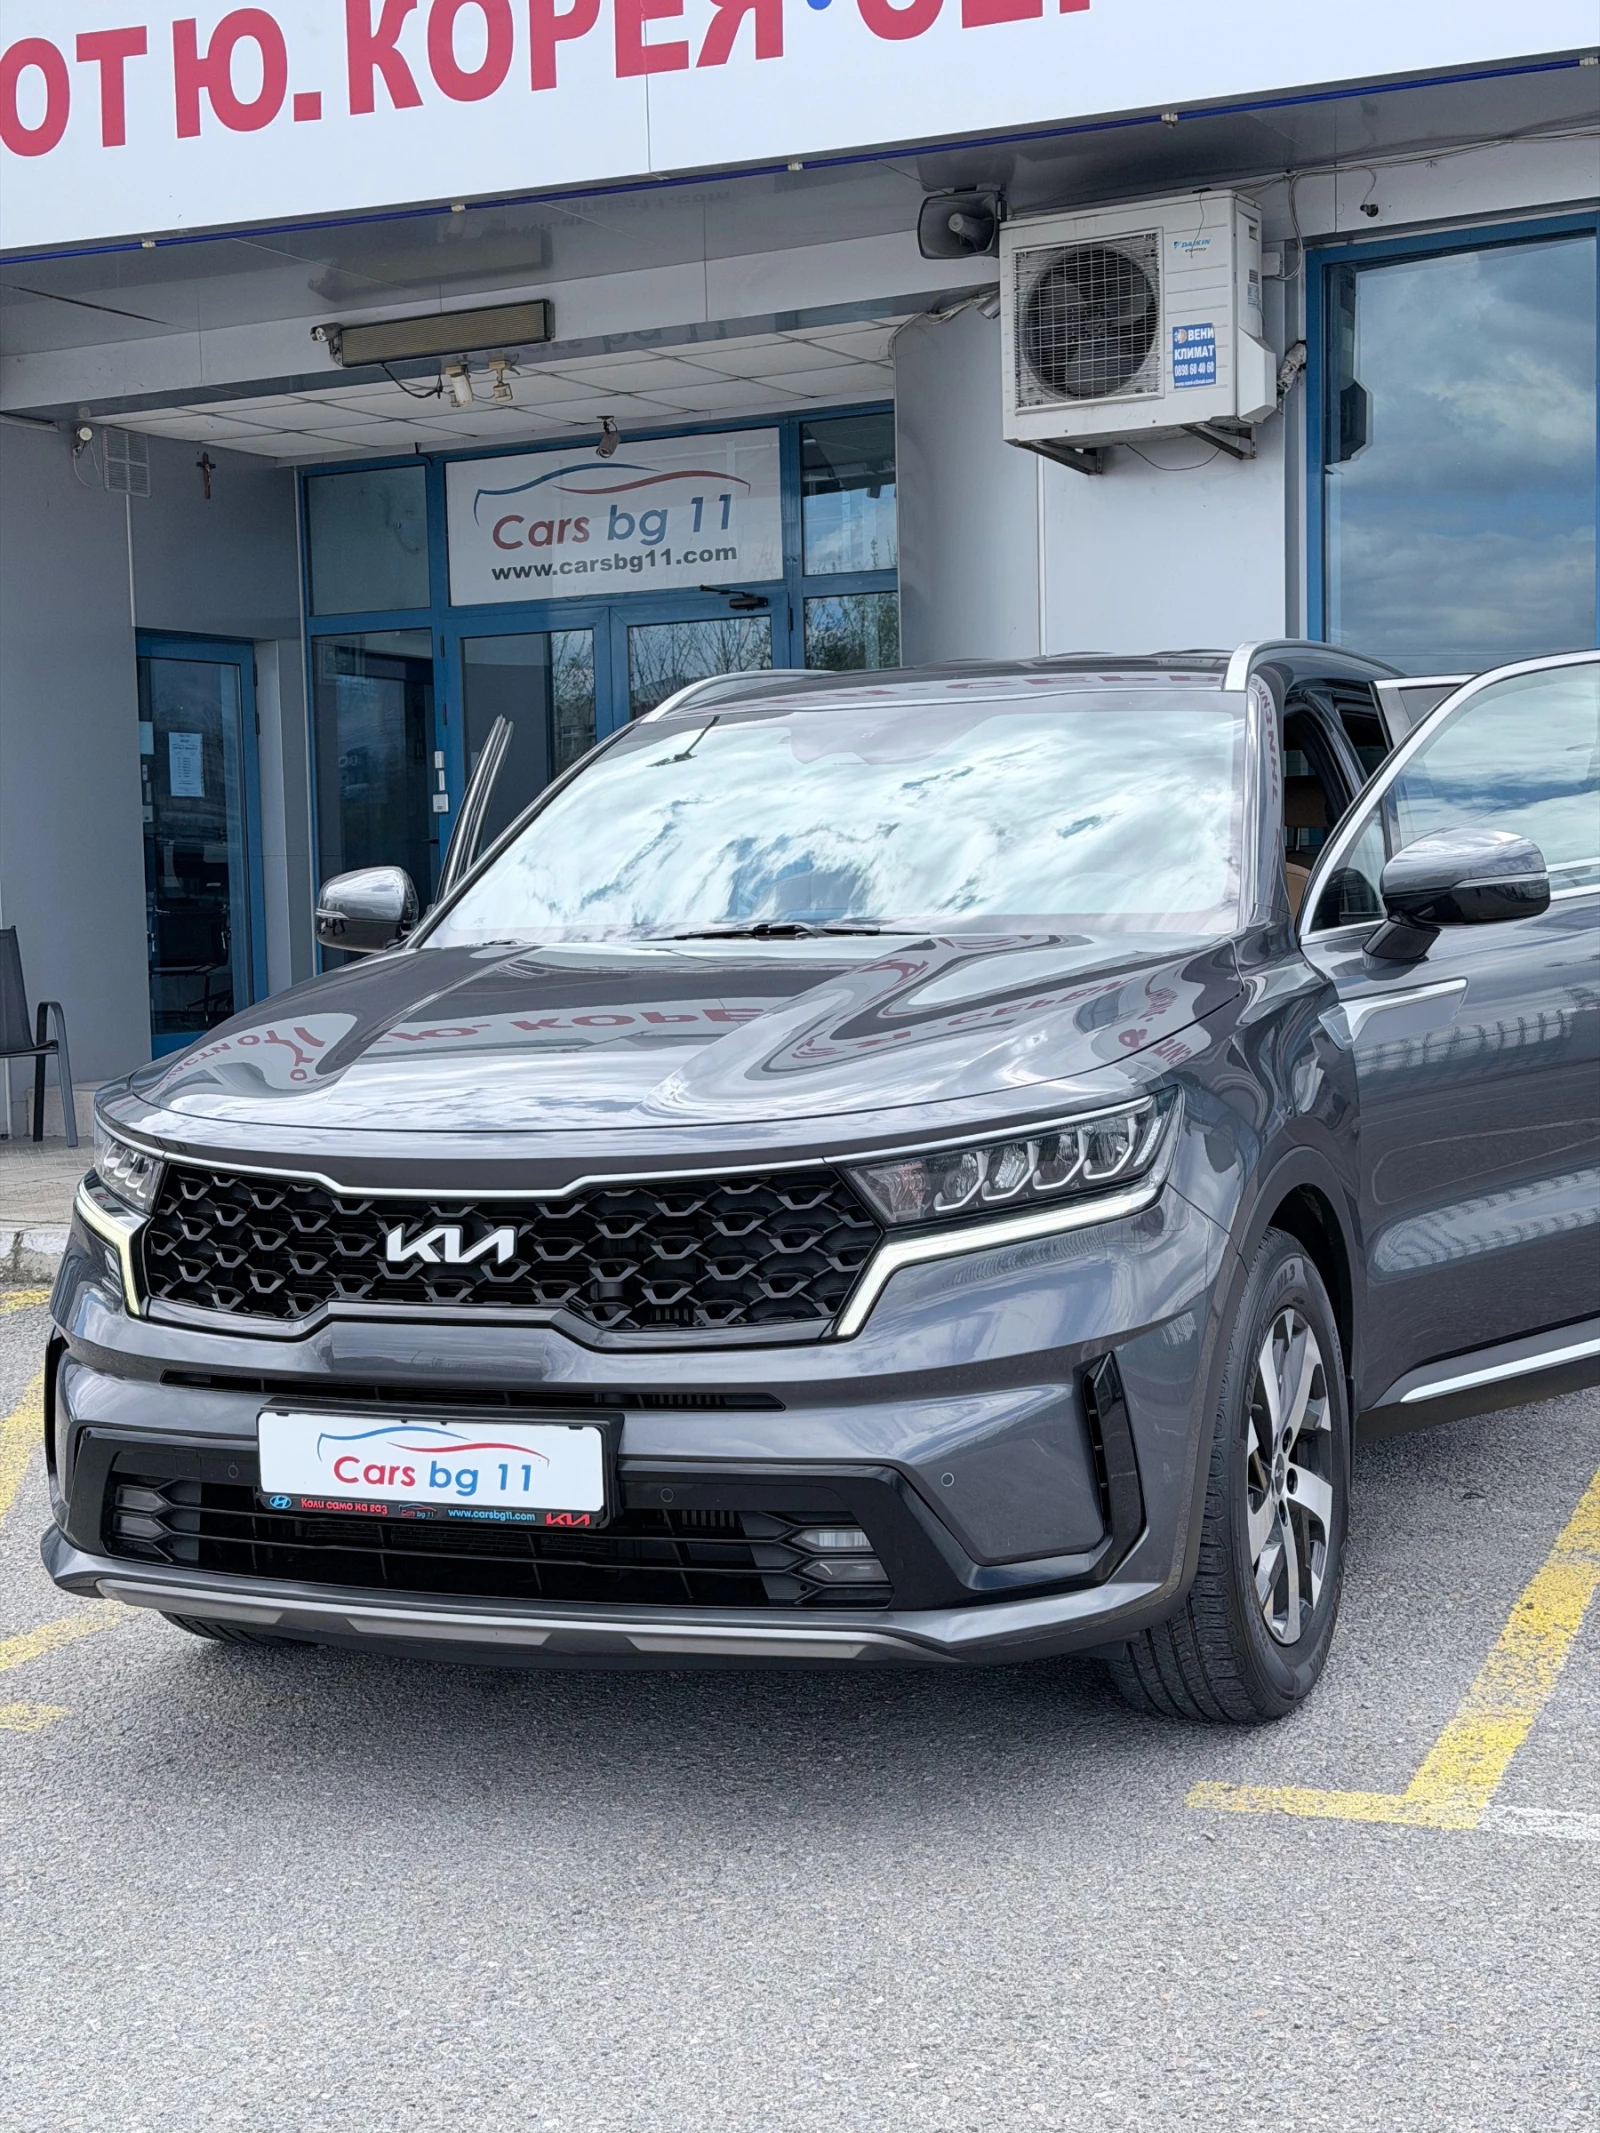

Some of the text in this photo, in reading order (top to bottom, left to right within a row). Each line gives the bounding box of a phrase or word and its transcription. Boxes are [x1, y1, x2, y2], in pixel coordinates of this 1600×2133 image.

[0, 25, 147, 157] ОТ
[172, 8, 322, 139] Ю.
[1181, 238, 1210, 248] DAIKIN
[1187, 327, 1214, 341] ВЕНИ
[1174, 344, 1214, 360] КЛИМАТ
[1189, 363, 1197, 375] 60
[1198, 362, 1206, 374] 40
[1206, 361, 1214, 373] 60
[492, 493, 732, 550] Cars bg 11
[491, 546, 737, 581] www.carsbg11.com
[386, 1222, 518, 1265] KIA
[333, 1456, 532, 1496] Cars bg 11
[300, 1497, 388, 1515] Коли само на газ
[447, 1508, 536, 1522] www.carsbg11.com
[545, 1512, 590, 1527] KIA
